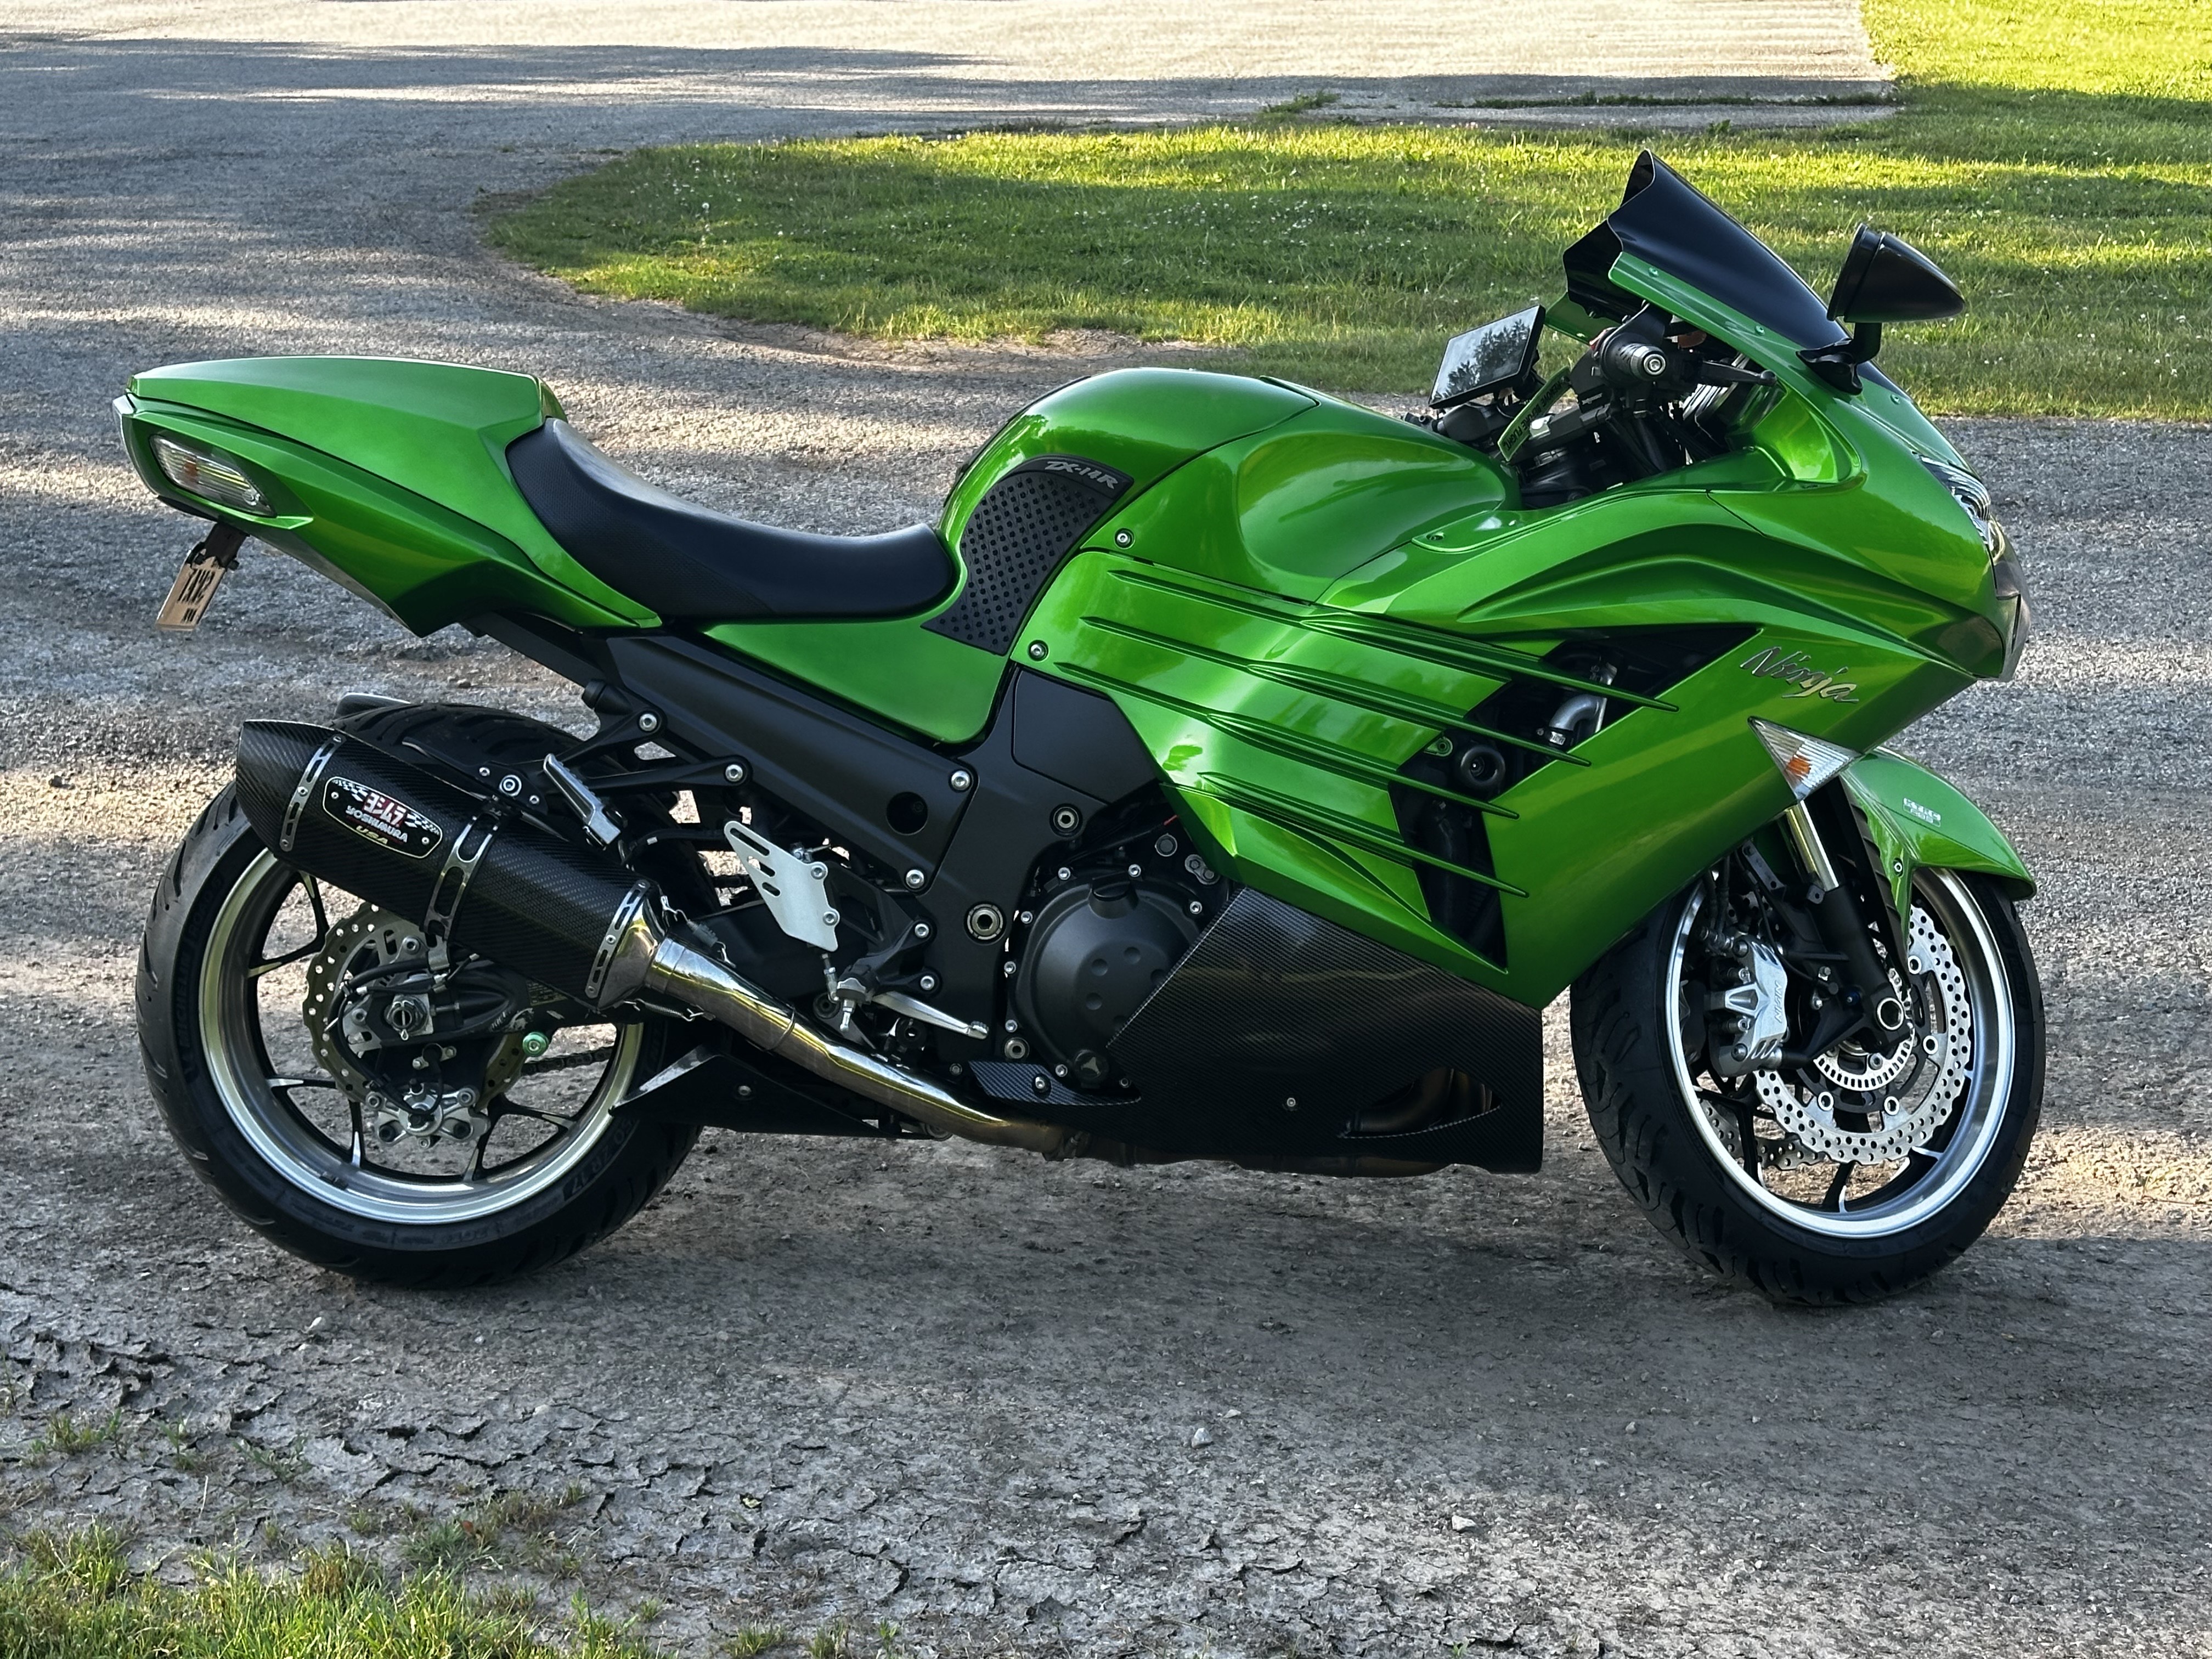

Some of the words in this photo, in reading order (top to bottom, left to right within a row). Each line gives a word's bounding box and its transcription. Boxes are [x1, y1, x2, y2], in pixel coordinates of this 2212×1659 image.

[1045, 461, 1118, 489] ZX-14R
[1740, 646, 1859, 703] Ninja
[345, 805, 408, 843] YOSHIMURA
[356, 825, 388, 844] USA
